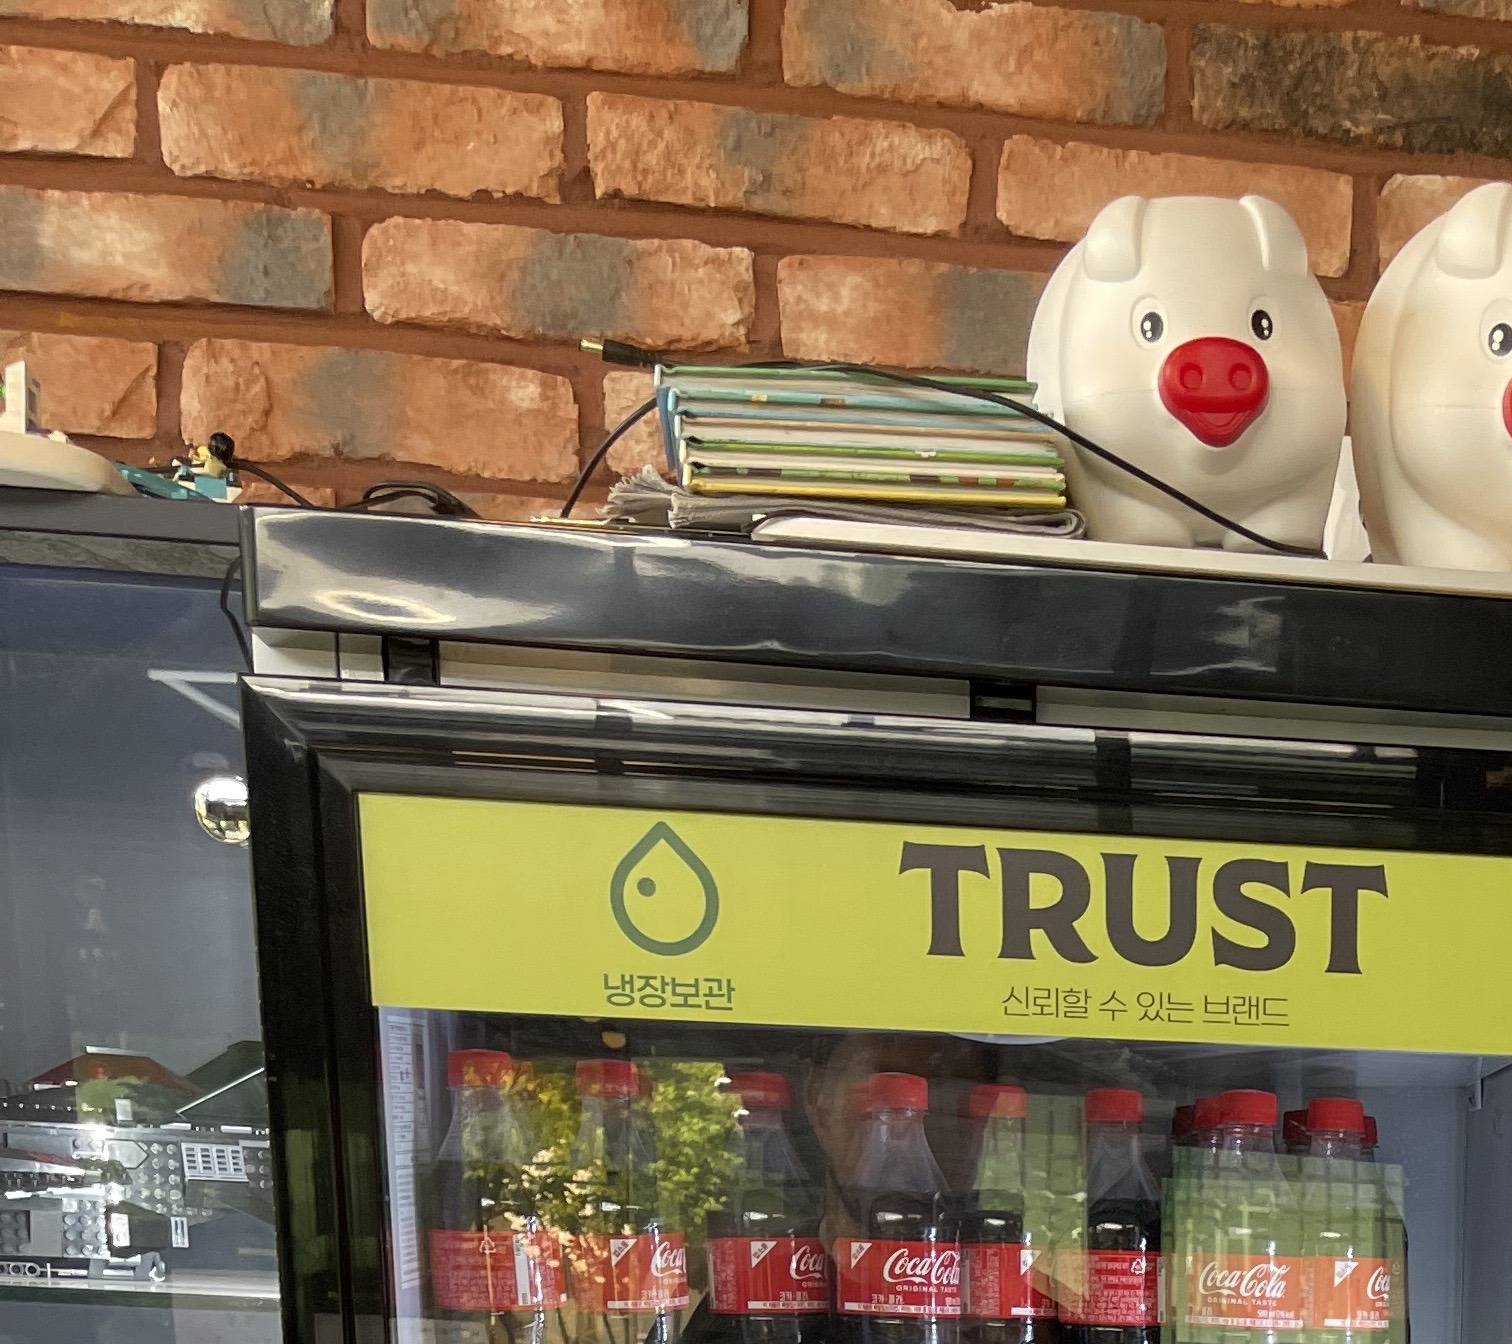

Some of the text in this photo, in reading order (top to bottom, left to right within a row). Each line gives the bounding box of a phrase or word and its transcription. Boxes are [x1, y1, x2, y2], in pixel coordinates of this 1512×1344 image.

[899, 838, 1389, 976] TRUST
[601, 971, 736, 1012] 냉장보관
[1000, 983, 1292, 1029] 신뢰할 수 있는 브랜드
[1199, 1261, 1290, 1299] Coca-Cola
[1207, 1297, 1278, 1308] ORIGINAL TASTE
